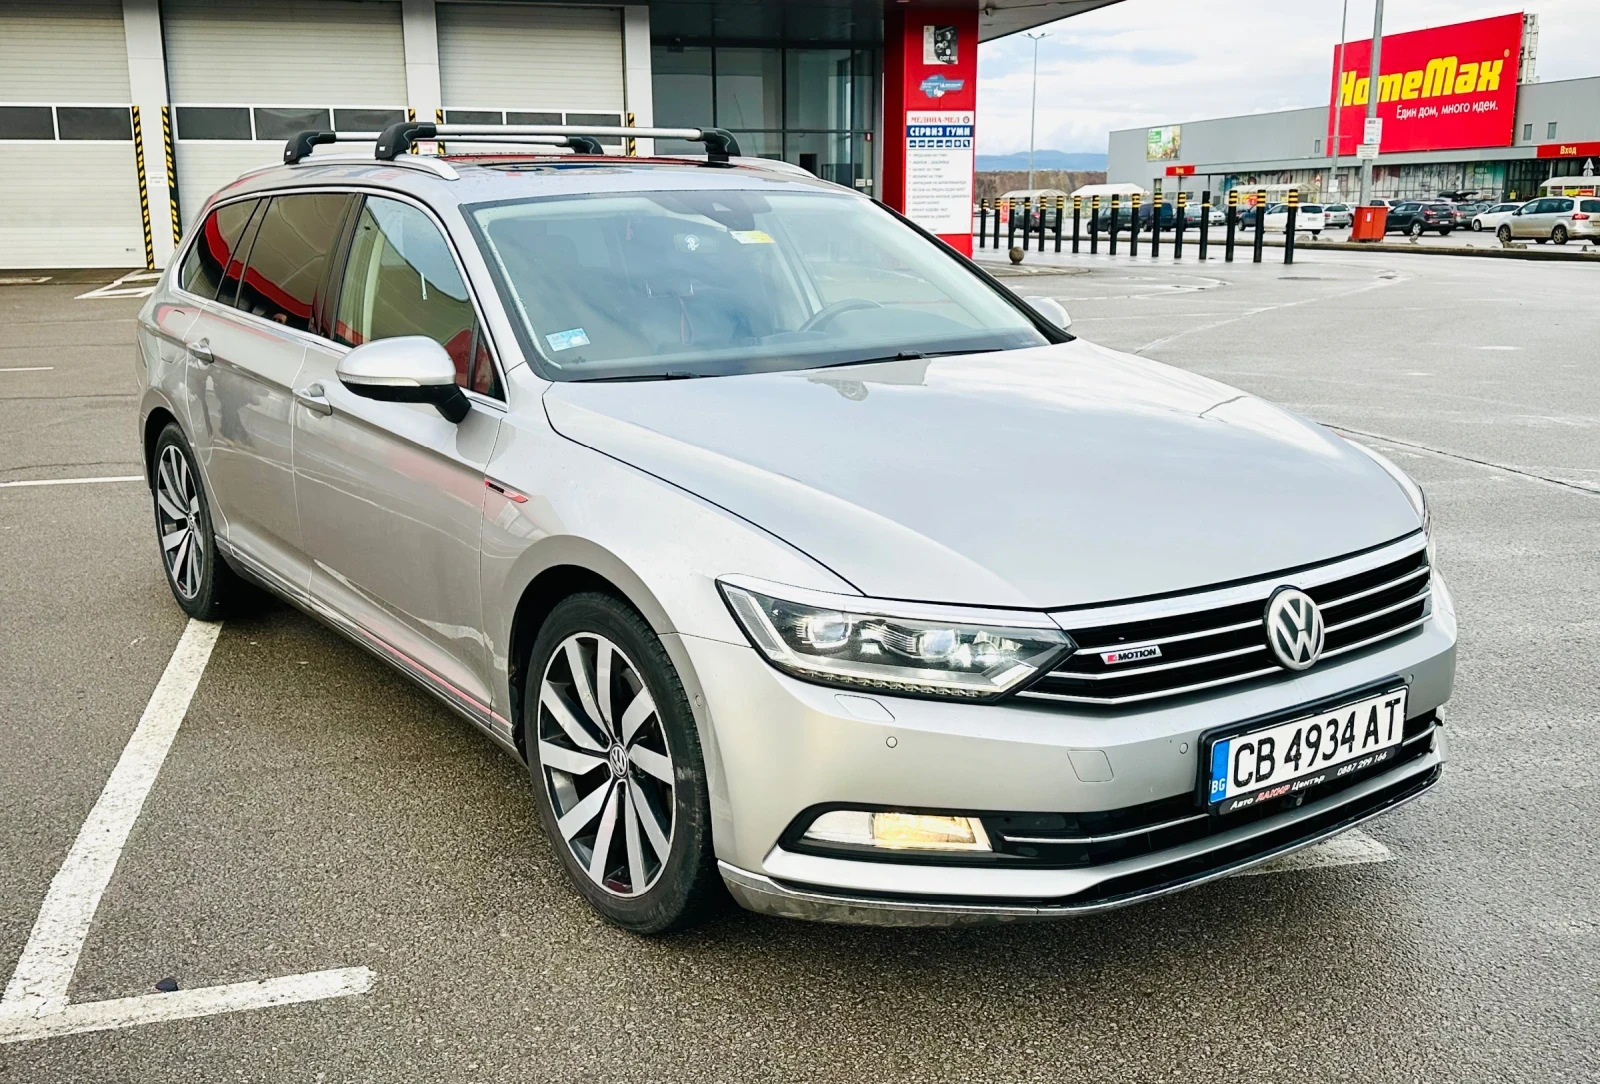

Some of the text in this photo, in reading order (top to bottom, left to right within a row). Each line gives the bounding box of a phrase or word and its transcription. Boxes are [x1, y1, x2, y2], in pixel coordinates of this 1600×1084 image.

[1336, 56, 1503, 107] HomeMax
[1396, 100, 1499, 120] Един дом, много идеи.
[910, 127, 970, 136] СЕРВИЗ ГУМИ
[1560, 145, 1577, 155] Вход
[1284, 711, 1356, 772] 4934
[1357, 757, 1373, 769] 299
[1374, 751, 1388, 763] 166
[1211, 777, 1226, 794] BG
[1230, 798, 1254, 811] Авто
